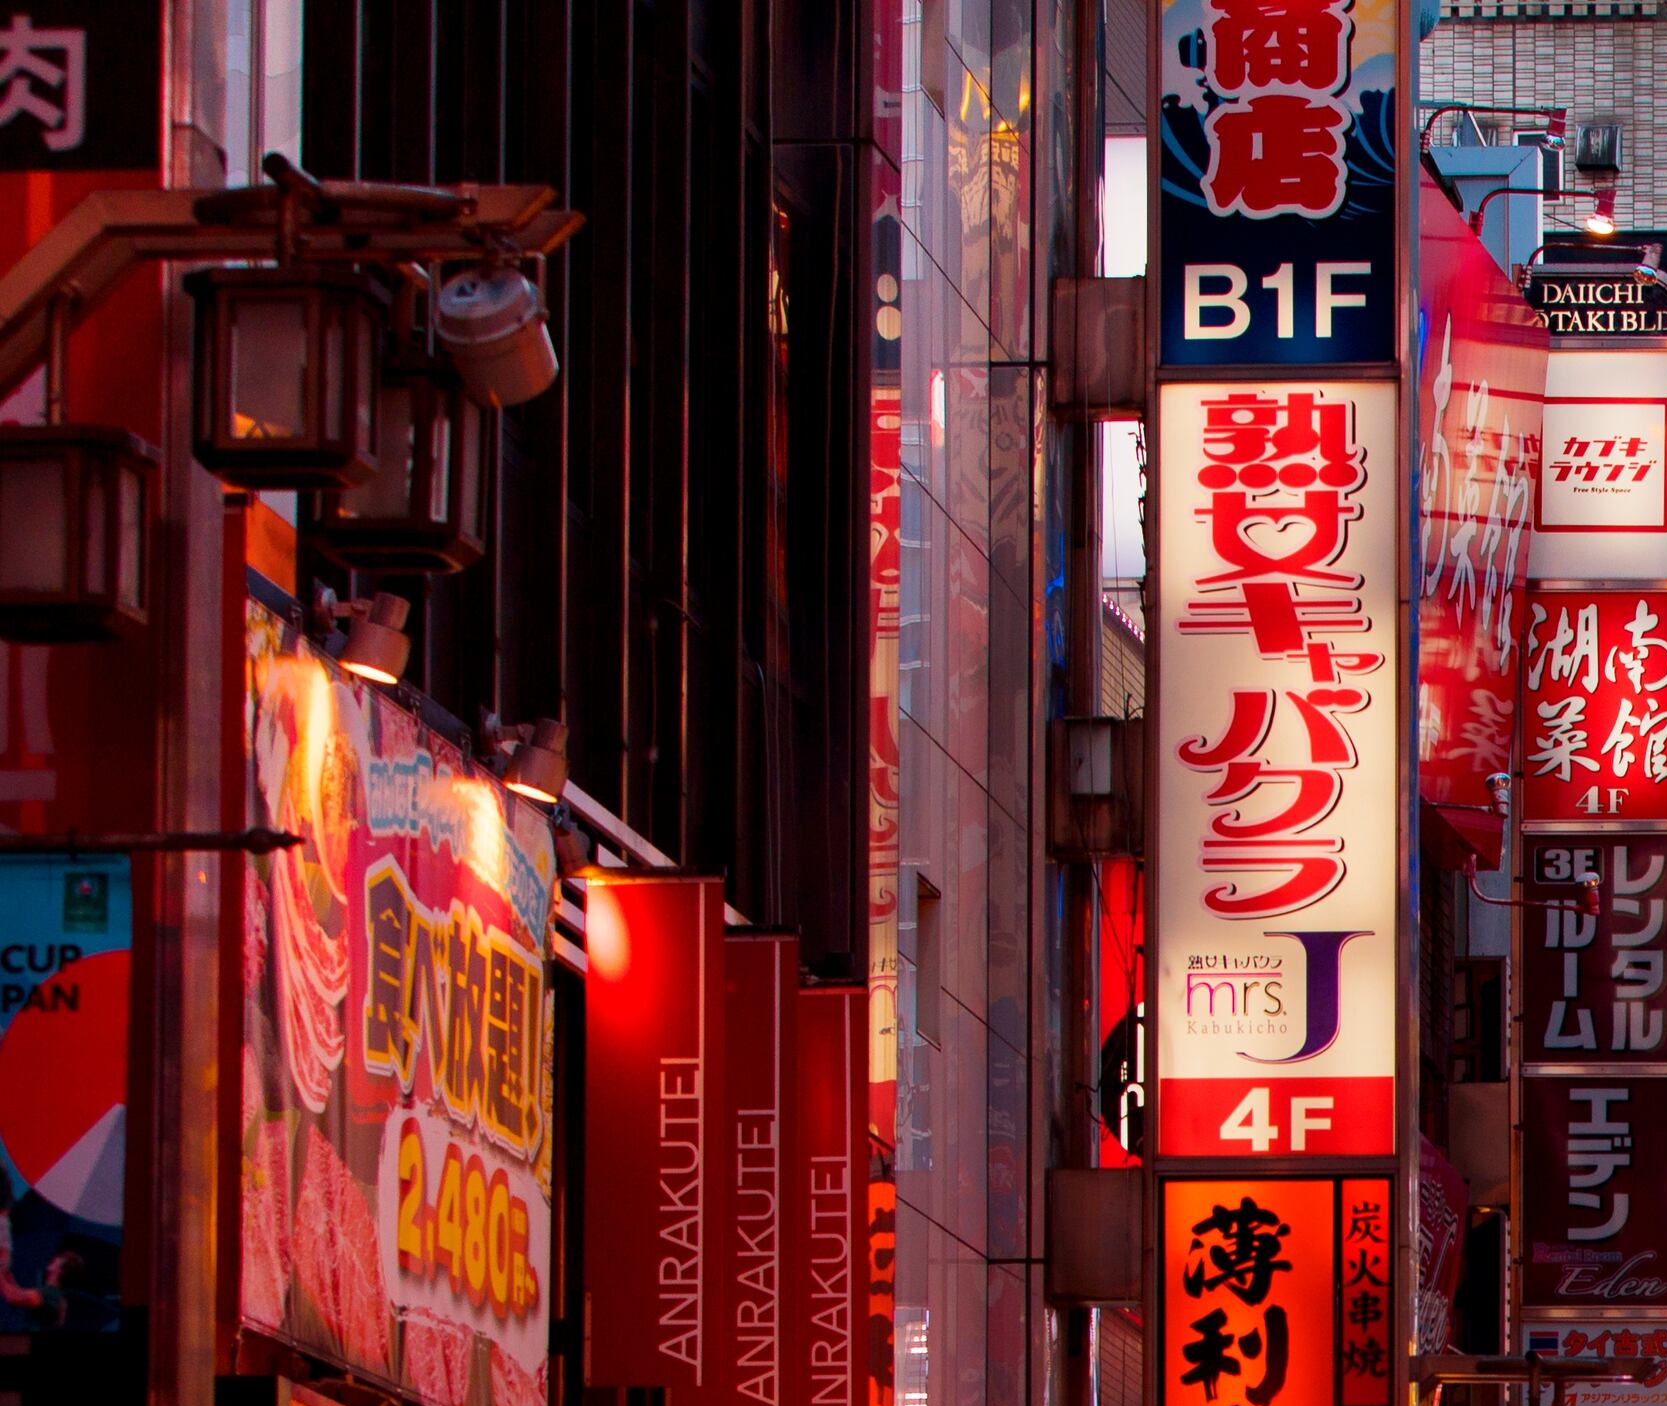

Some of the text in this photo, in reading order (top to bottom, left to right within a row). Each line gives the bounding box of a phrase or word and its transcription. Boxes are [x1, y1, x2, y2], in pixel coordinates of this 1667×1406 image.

[1183, 262, 1372, 340] B1F
[1543, 284, 1645, 306] DAIICHI
[1549, 461, 1658, 483] ラウンジ
[1562, 436, 1648, 459] カブキ
[1178, 392, 1386, 922] 熟女キャバクラ
[1575, 785, 1630, 815] 4F
[1543, 900, 1598, 1051] ルーム
[1612, 846, 1665, 1051] レンタル
[1187, 1020, 1289, 1036] Kabukicho
[1218, 1086, 1336, 1153] 4F
[1567, 1087, 1632, 1240] エデン
[659, 1057, 700, 1368] ANRAKUTEI
[736, 1109, 777, 1405] ANRAKUTEI
[1345, 1203, 1389, 1378] 炭火串焼
